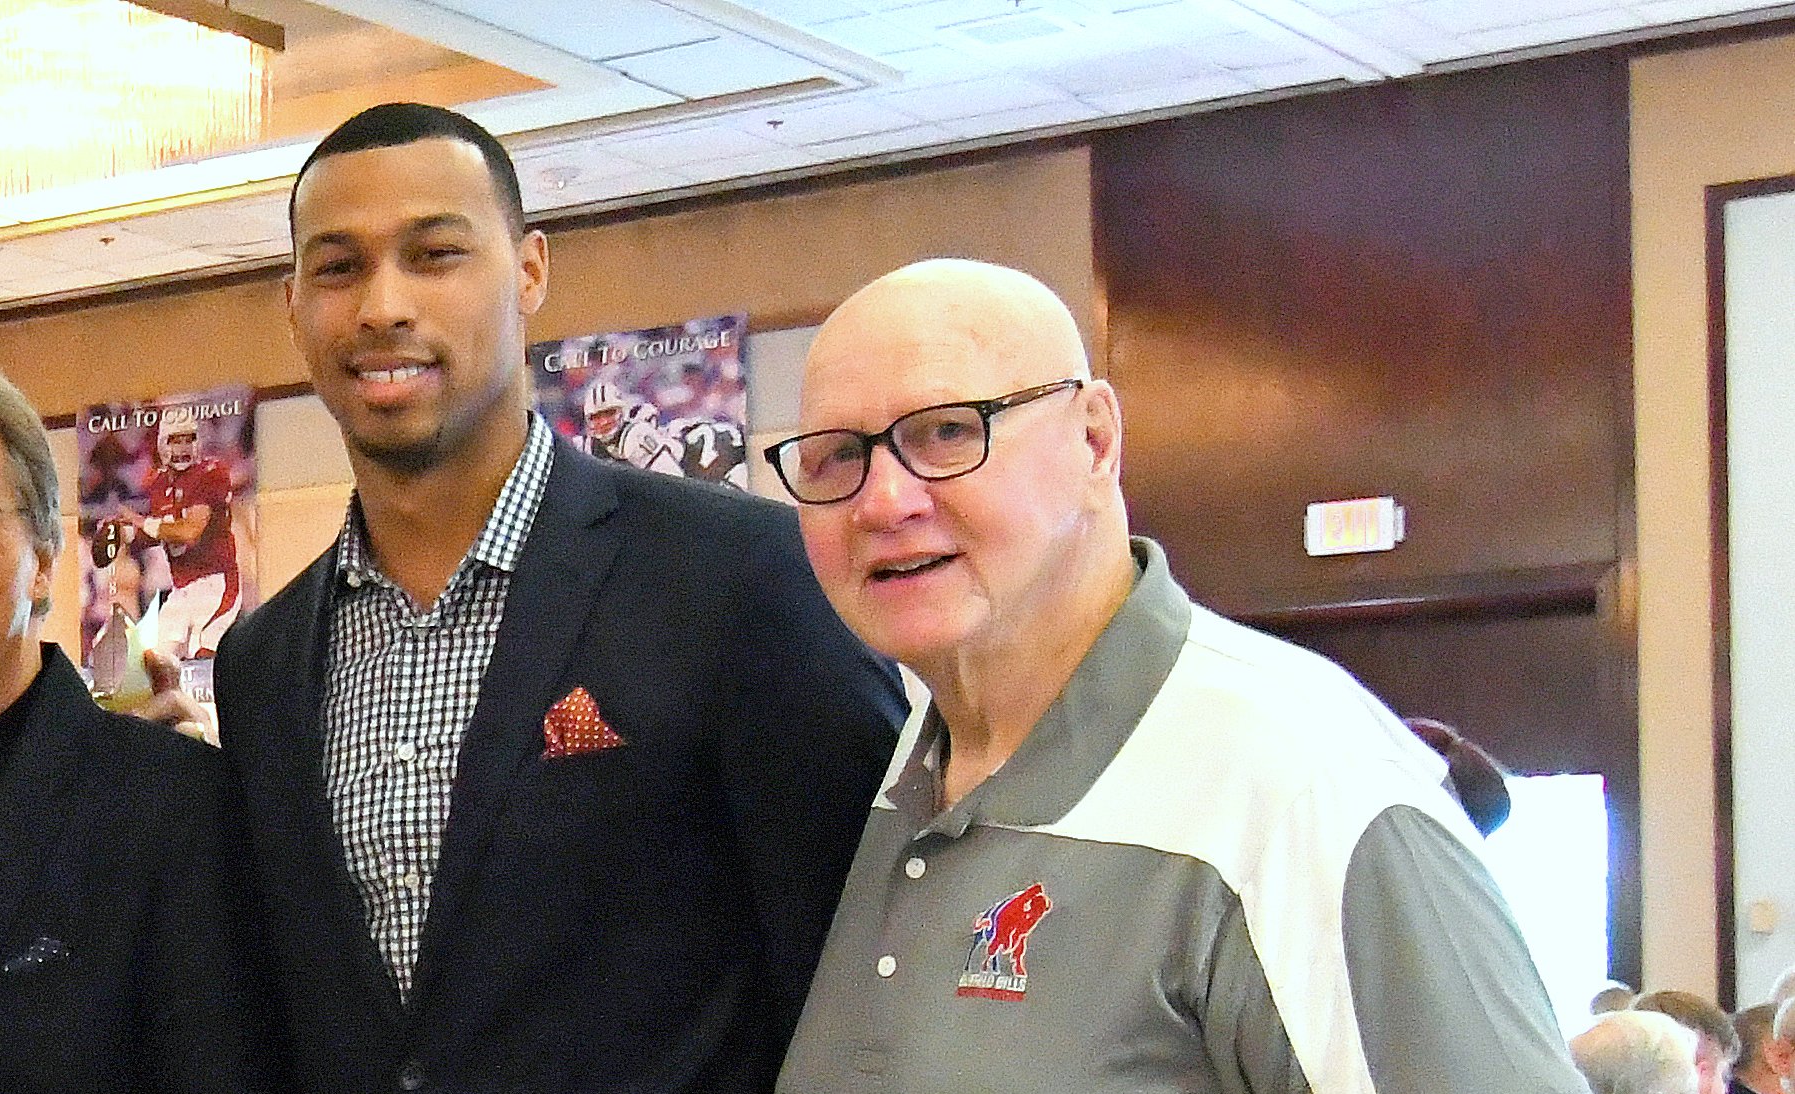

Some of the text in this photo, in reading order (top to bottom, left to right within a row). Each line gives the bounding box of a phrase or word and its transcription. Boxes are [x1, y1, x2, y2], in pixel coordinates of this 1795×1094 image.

[633, 330, 731, 360] COURAGE
[88, 400, 241, 434] CALL TO COURAGE
